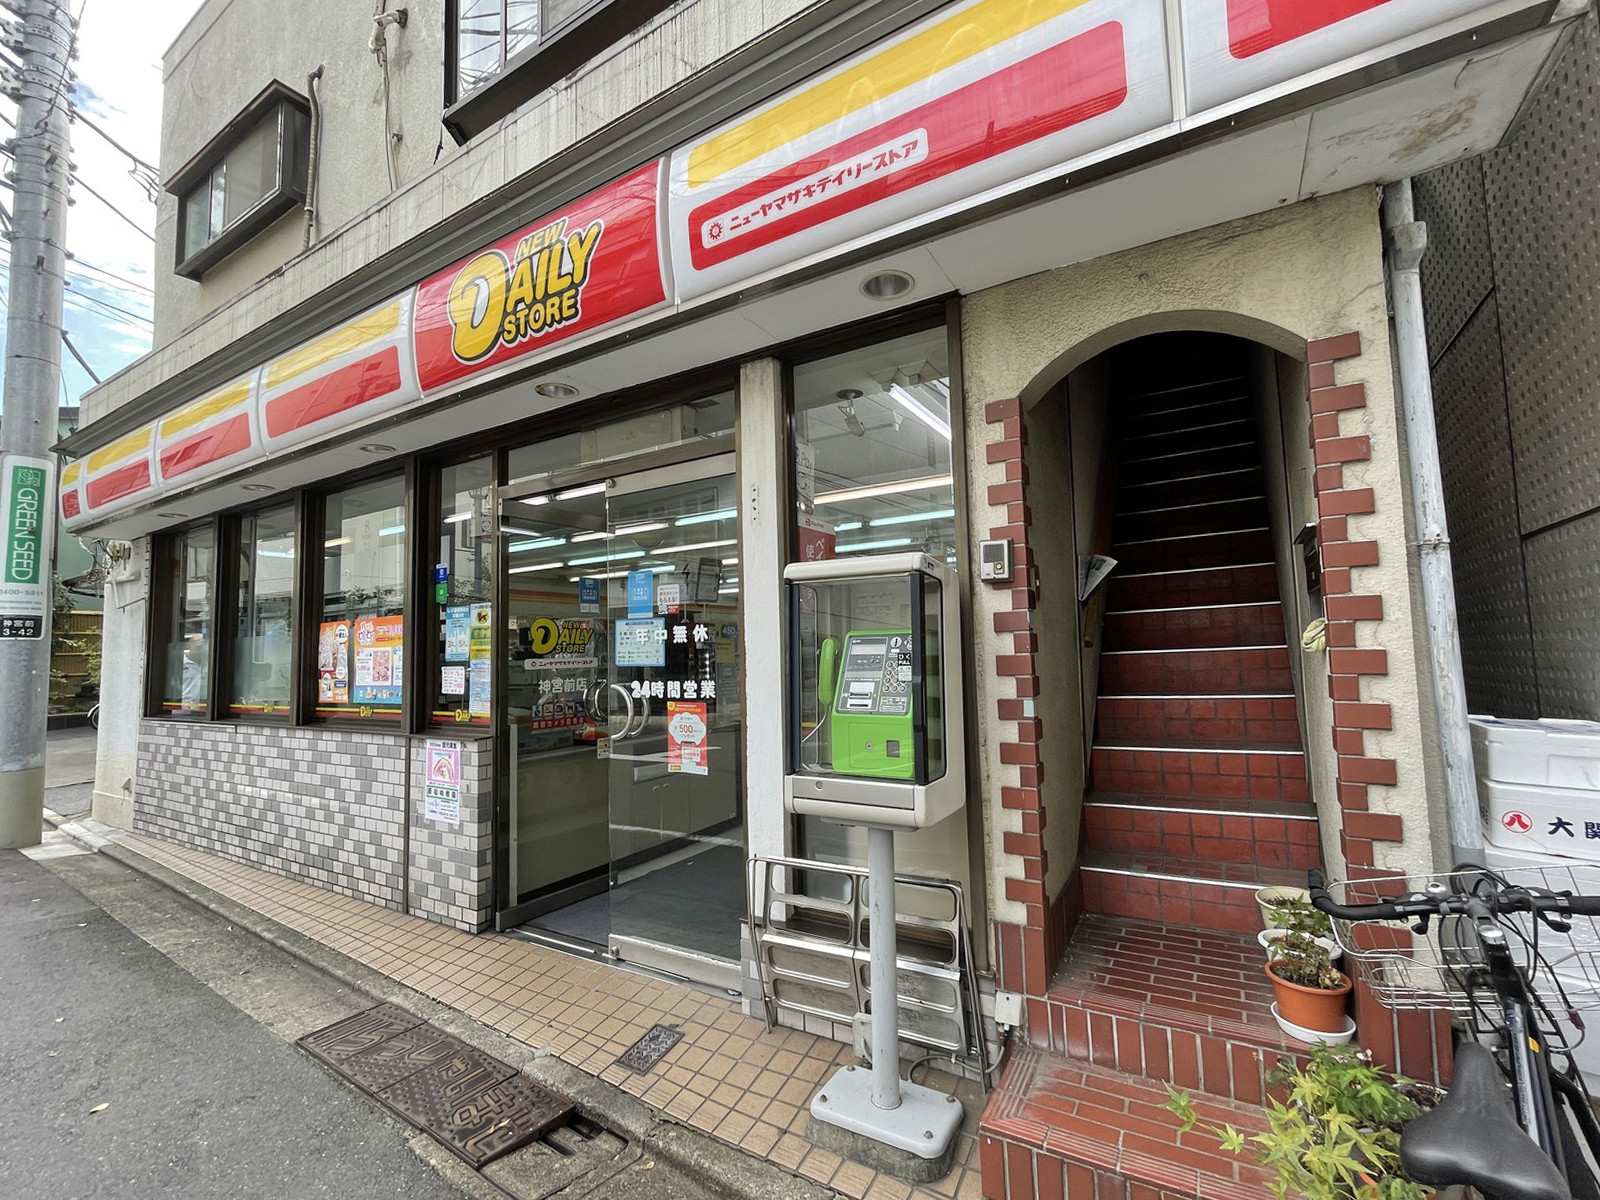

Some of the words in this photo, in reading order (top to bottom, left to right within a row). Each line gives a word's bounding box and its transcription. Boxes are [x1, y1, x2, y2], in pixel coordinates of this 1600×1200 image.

[729, 139, 919, 231] ニューヤマザキデイリーストア
[516, 219, 566, 260] NEW
[449, 220, 603, 363] DAILY
[502, 290, 579, 344] STORE
[14, 487, 38, 538] GREEN
[11, 540, 36, 581] SEED
[2, 628, 34, 636] 3-42
[3, 619, 35, 628] 神宮前
[530, 617, 594, 654] DAILY
[562, 621, 581, 629] NEW
[635, 624, 709, 644] 年中無休
[555, 644, 586, 654] STORE
[538, 677, 588, 694] 神宮前店
[631, 680, 717, 699] 24時間営業
